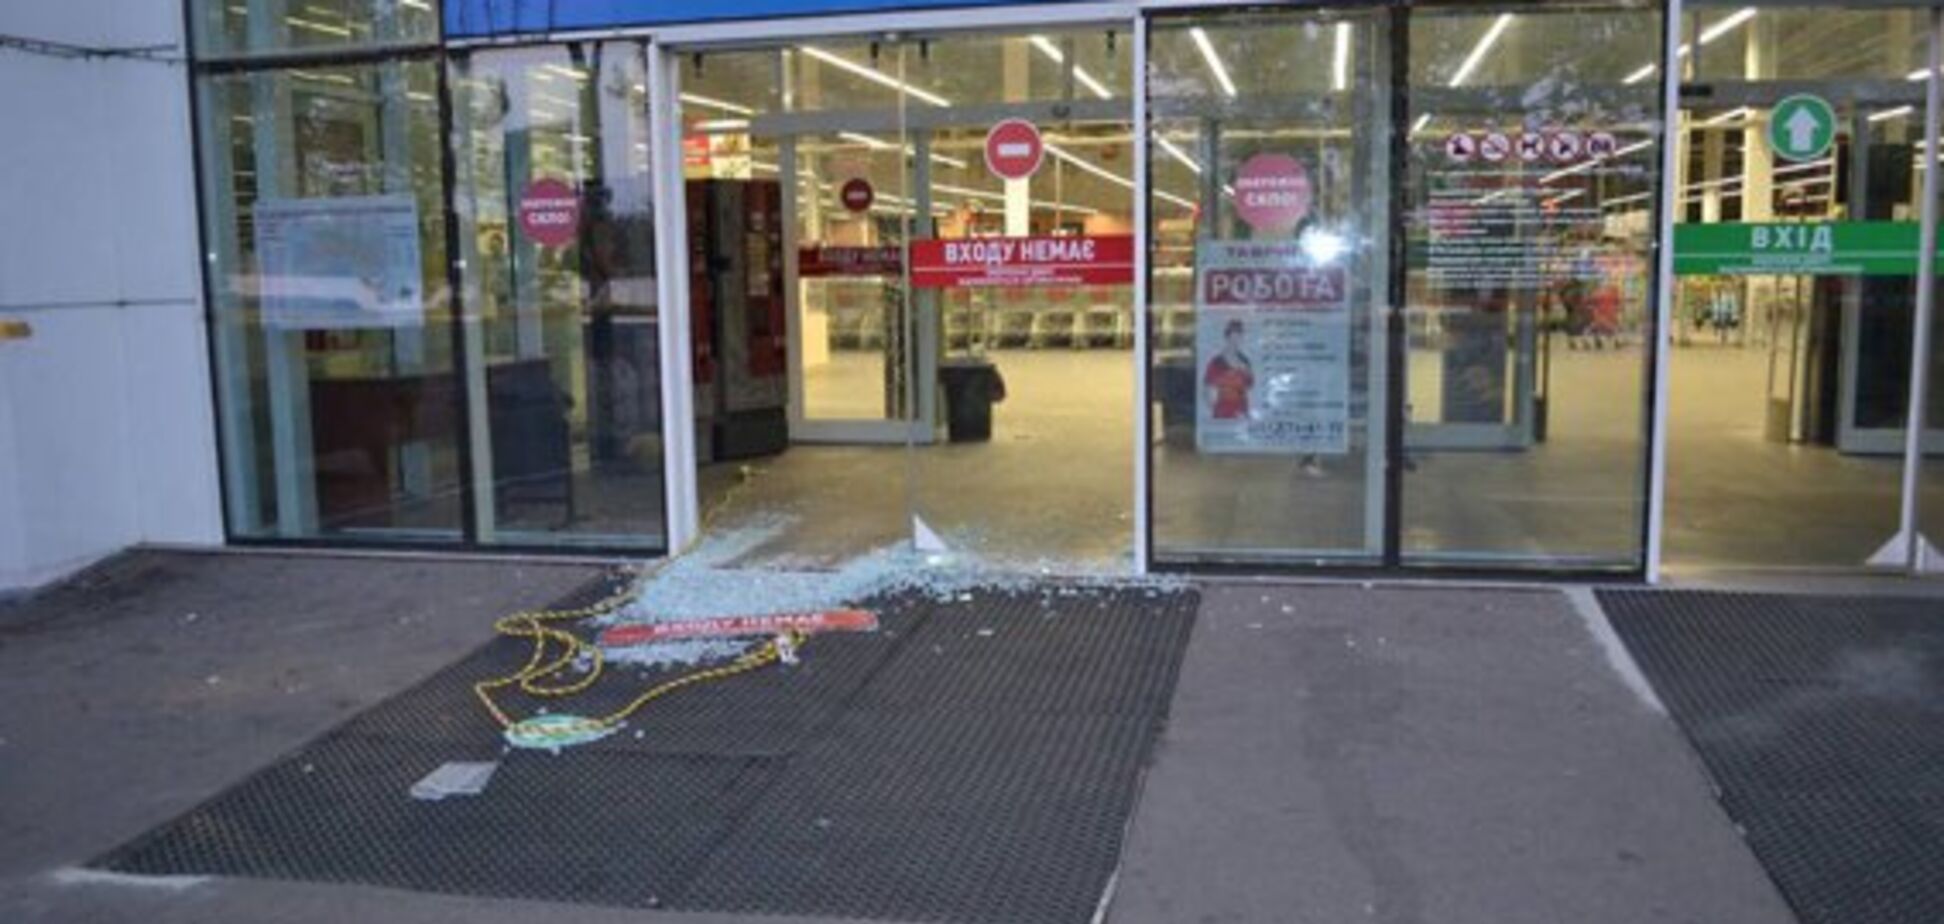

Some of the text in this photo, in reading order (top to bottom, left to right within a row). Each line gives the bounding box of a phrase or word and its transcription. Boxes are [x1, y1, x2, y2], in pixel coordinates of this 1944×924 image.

[944, 239, 1096, 264] ВХОДУ НЕМАЄ
[1751, 225, 1833, 252] ВХІД
[1210, 271, 1336, 301] РОБОТА
